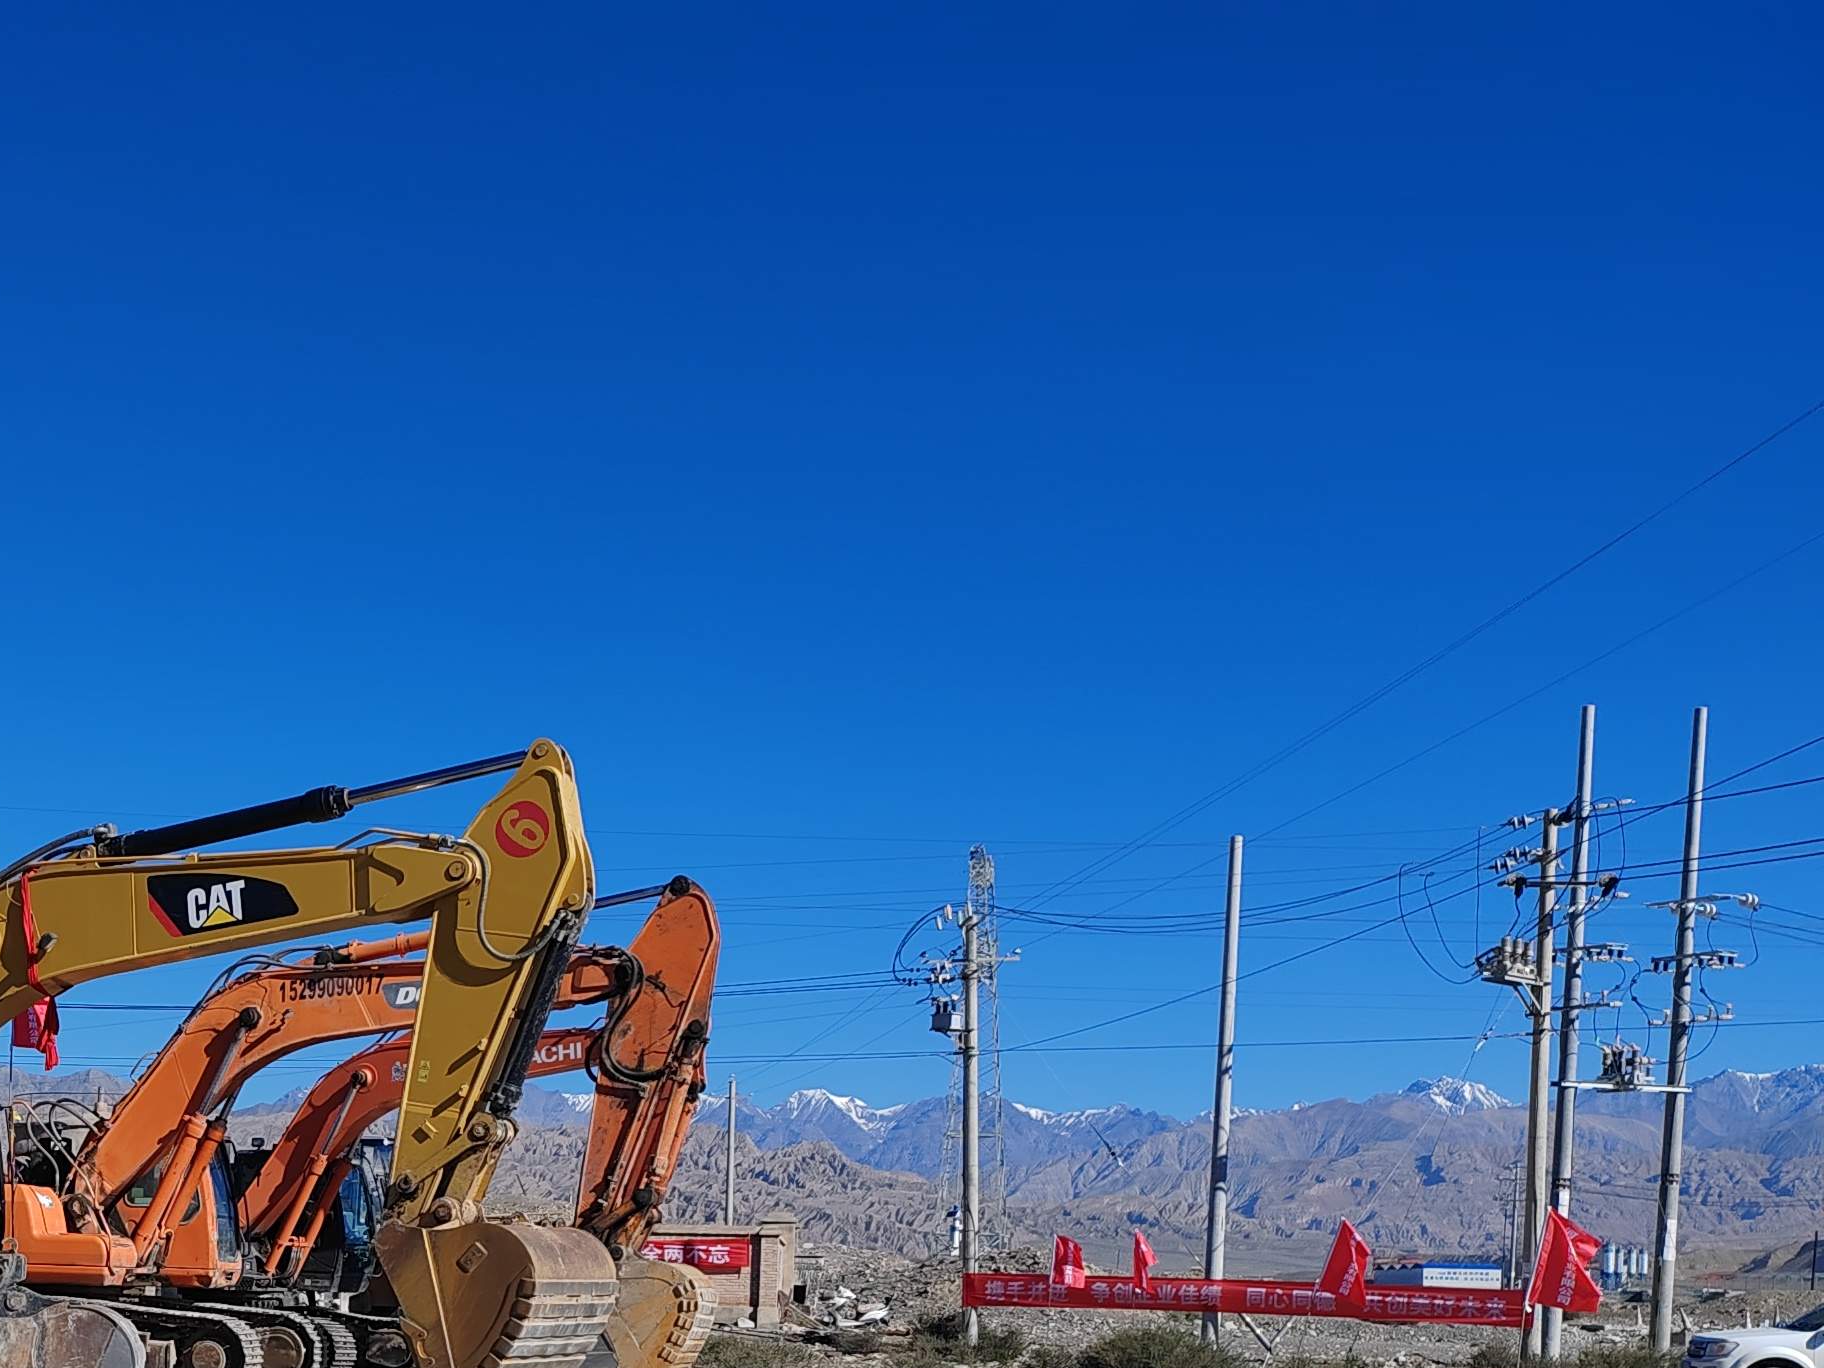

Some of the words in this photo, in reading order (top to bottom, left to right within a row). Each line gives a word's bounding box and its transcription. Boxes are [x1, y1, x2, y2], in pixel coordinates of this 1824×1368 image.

[501, 808, 545, 850] 6
[187, 880, 245, 929] CAT
[279, 973, 384, 1003] 15299090017
